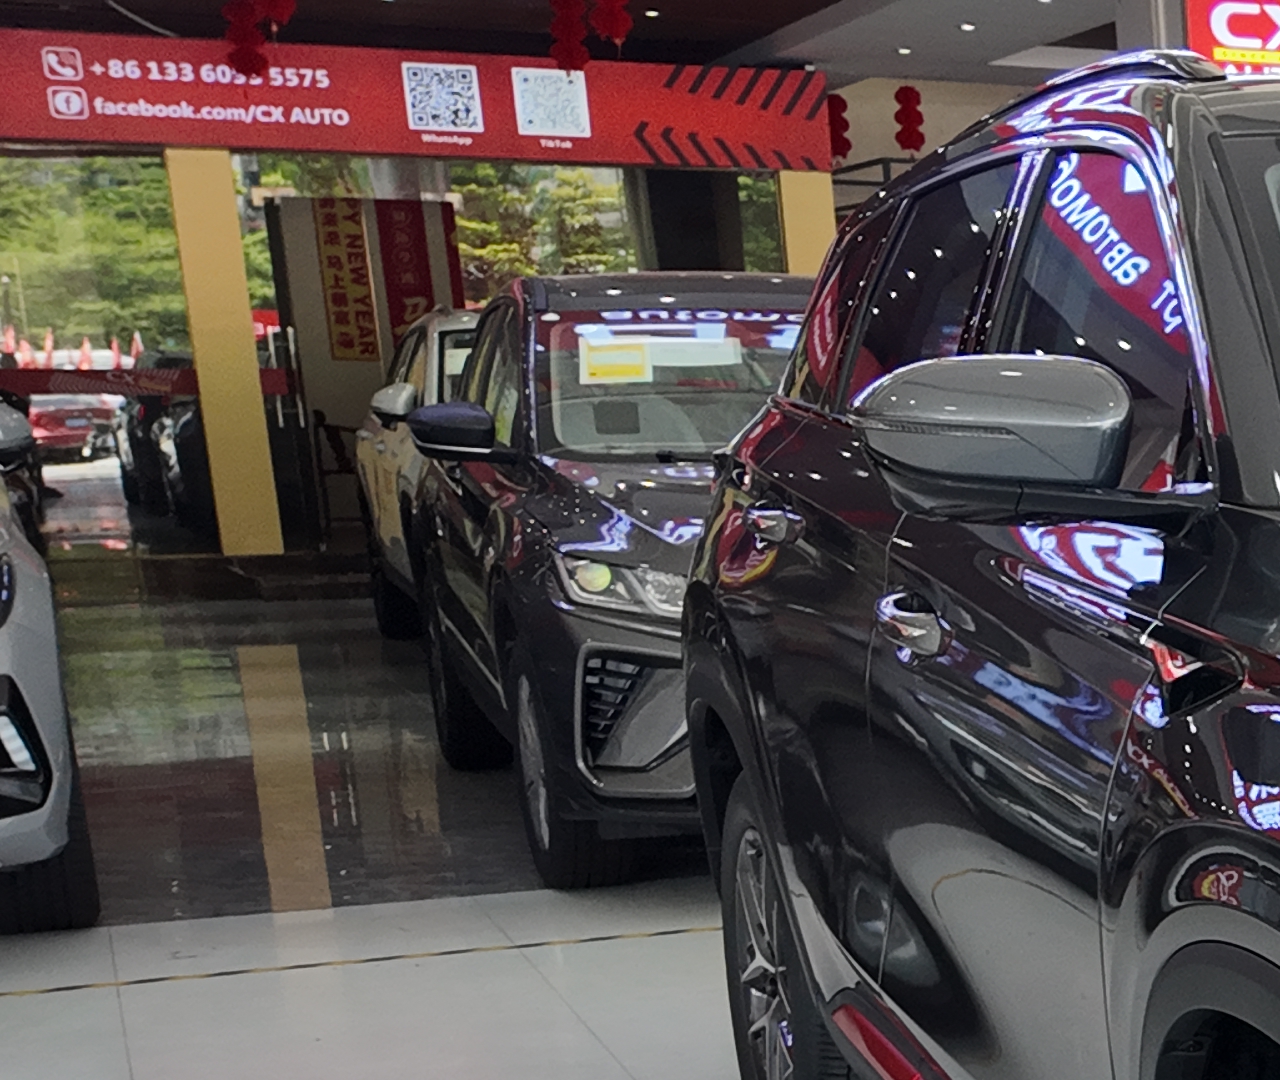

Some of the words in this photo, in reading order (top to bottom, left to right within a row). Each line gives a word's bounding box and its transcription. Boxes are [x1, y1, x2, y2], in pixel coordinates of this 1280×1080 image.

[89, 58, 142, 80] +86
[146, 61, 195, 82] 133
[268, 67, 331, 88] 5575
[93, 96, 285, 124] facebook.com/CX
[289, 106, 350, 126] AUTO
[353, 294, 377, 356] YEAR
